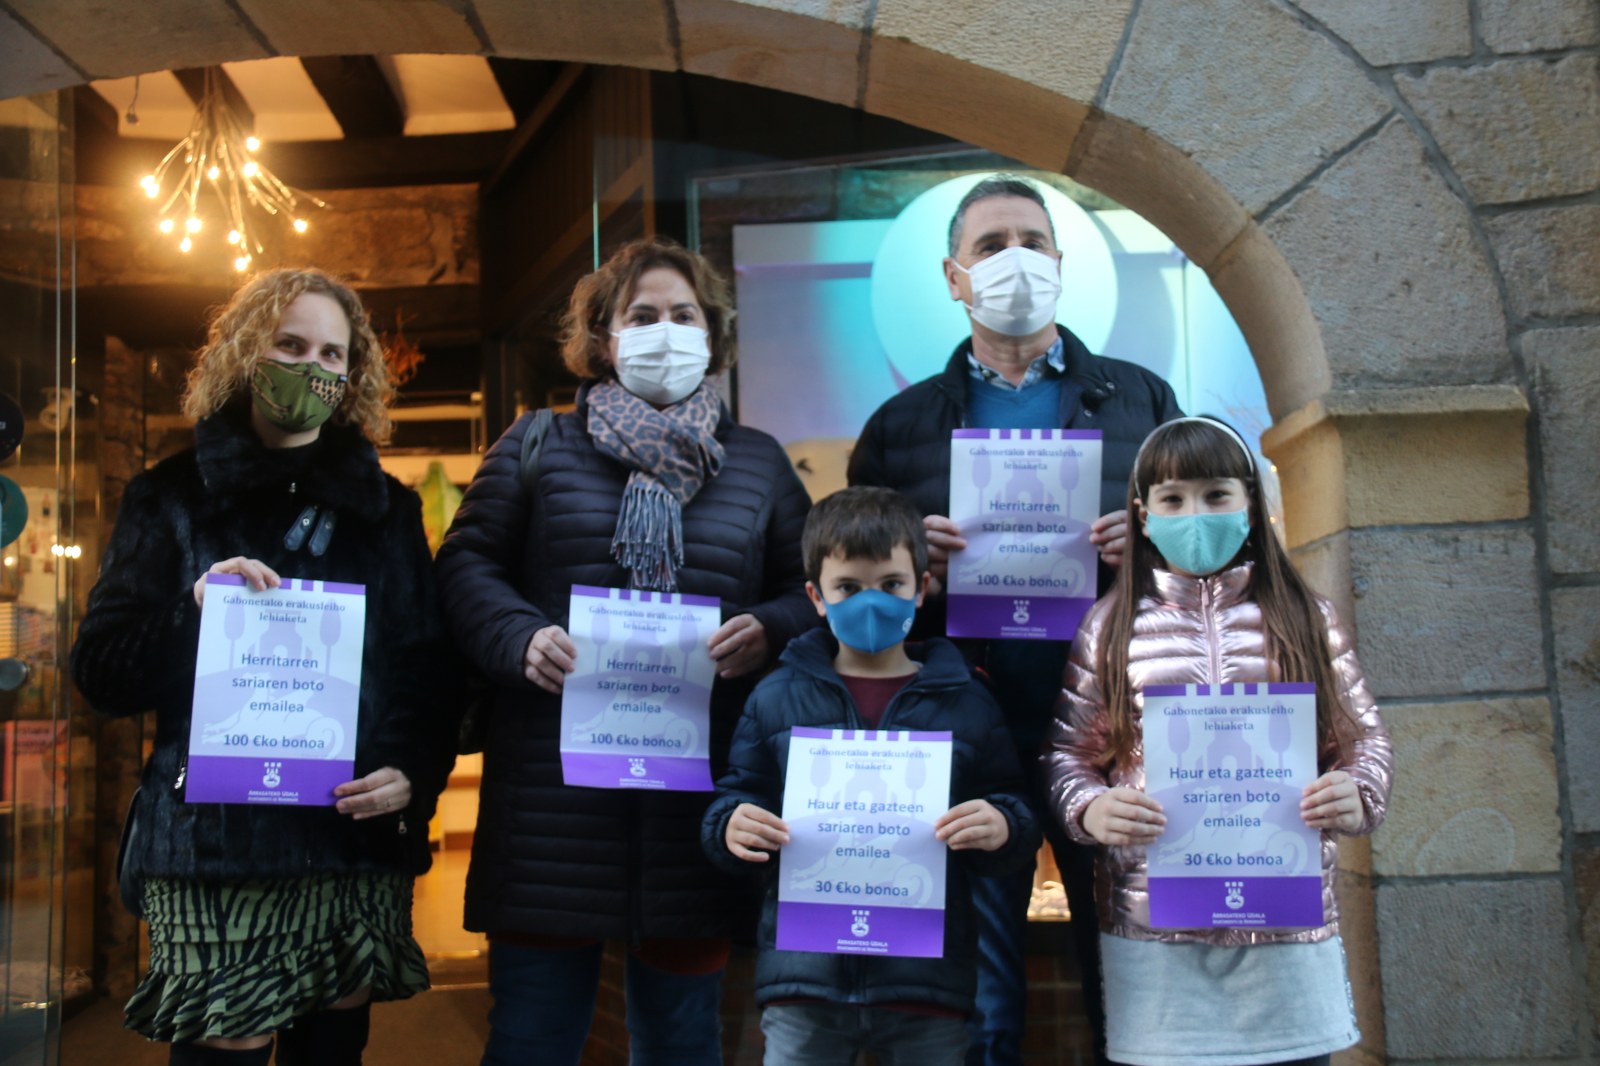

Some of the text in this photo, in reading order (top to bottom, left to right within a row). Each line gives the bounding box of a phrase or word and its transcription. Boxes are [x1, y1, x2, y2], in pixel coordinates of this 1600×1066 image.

[990, 501, 1060, 512] Herritarren
[982, 521, 1066, 533] sariaren boto
[999, 542, 1048, 554] emailea
[977, 575, 1068, 587] 100 €ko bonoa
[223, 596, 345, 611] Gabonetako erakusleiho
[260, 613, 307, 623] lehiaketa
[242, 654, 318, 668] Herritarren
[607, 659, 676, 673] Herritarren
[232, 676, 324, 690] sariaren boto
[598, 680, 680, 693] sariaren boto
[250, 700, 304, 712] emailea
[613, 702, 661, 713] emailea
[1164, 706, 1294, 716] Gabonetako erakusleiho
[1204, 721, 1254, 730] lehiaketa
[224, 735, 324, 748] 100 €ko bonoa
[591, 733, 681, 748] 100 €ko bonoa
[1170, 768, 1292, 780] Haur eta gazteen
[1183, 791, 1280, 803] sariaren boto
[808, 799, 923, 813] Haur eta gazteen
[1204, 815, 1261, 827] emailea
[818, 821, 910, 835] sariaren boto
[836, 846, 890, 858] emailea
[1185, 854, 1283, 865] 30 €ko bonoa
[816, 881, 908, 896] 30 €ko bonoa
